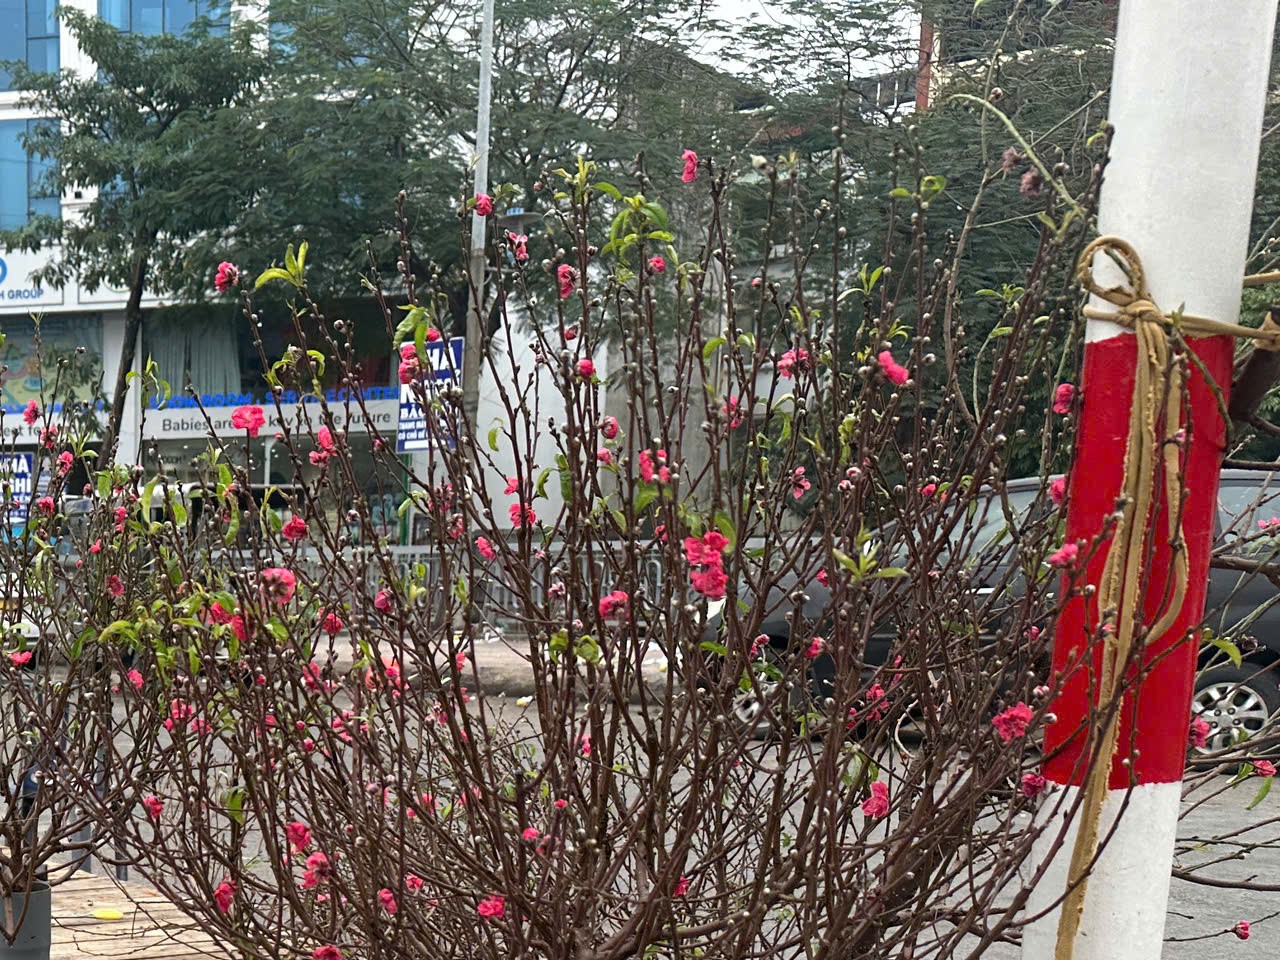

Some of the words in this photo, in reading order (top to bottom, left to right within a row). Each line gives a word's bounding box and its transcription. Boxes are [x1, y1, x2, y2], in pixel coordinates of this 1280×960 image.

[7, 288, 44, 300] GROUP
[162, 418, 209, 431] Babies
[268, 415, 293, 428] ky
[319, 413, 341, 426] te
